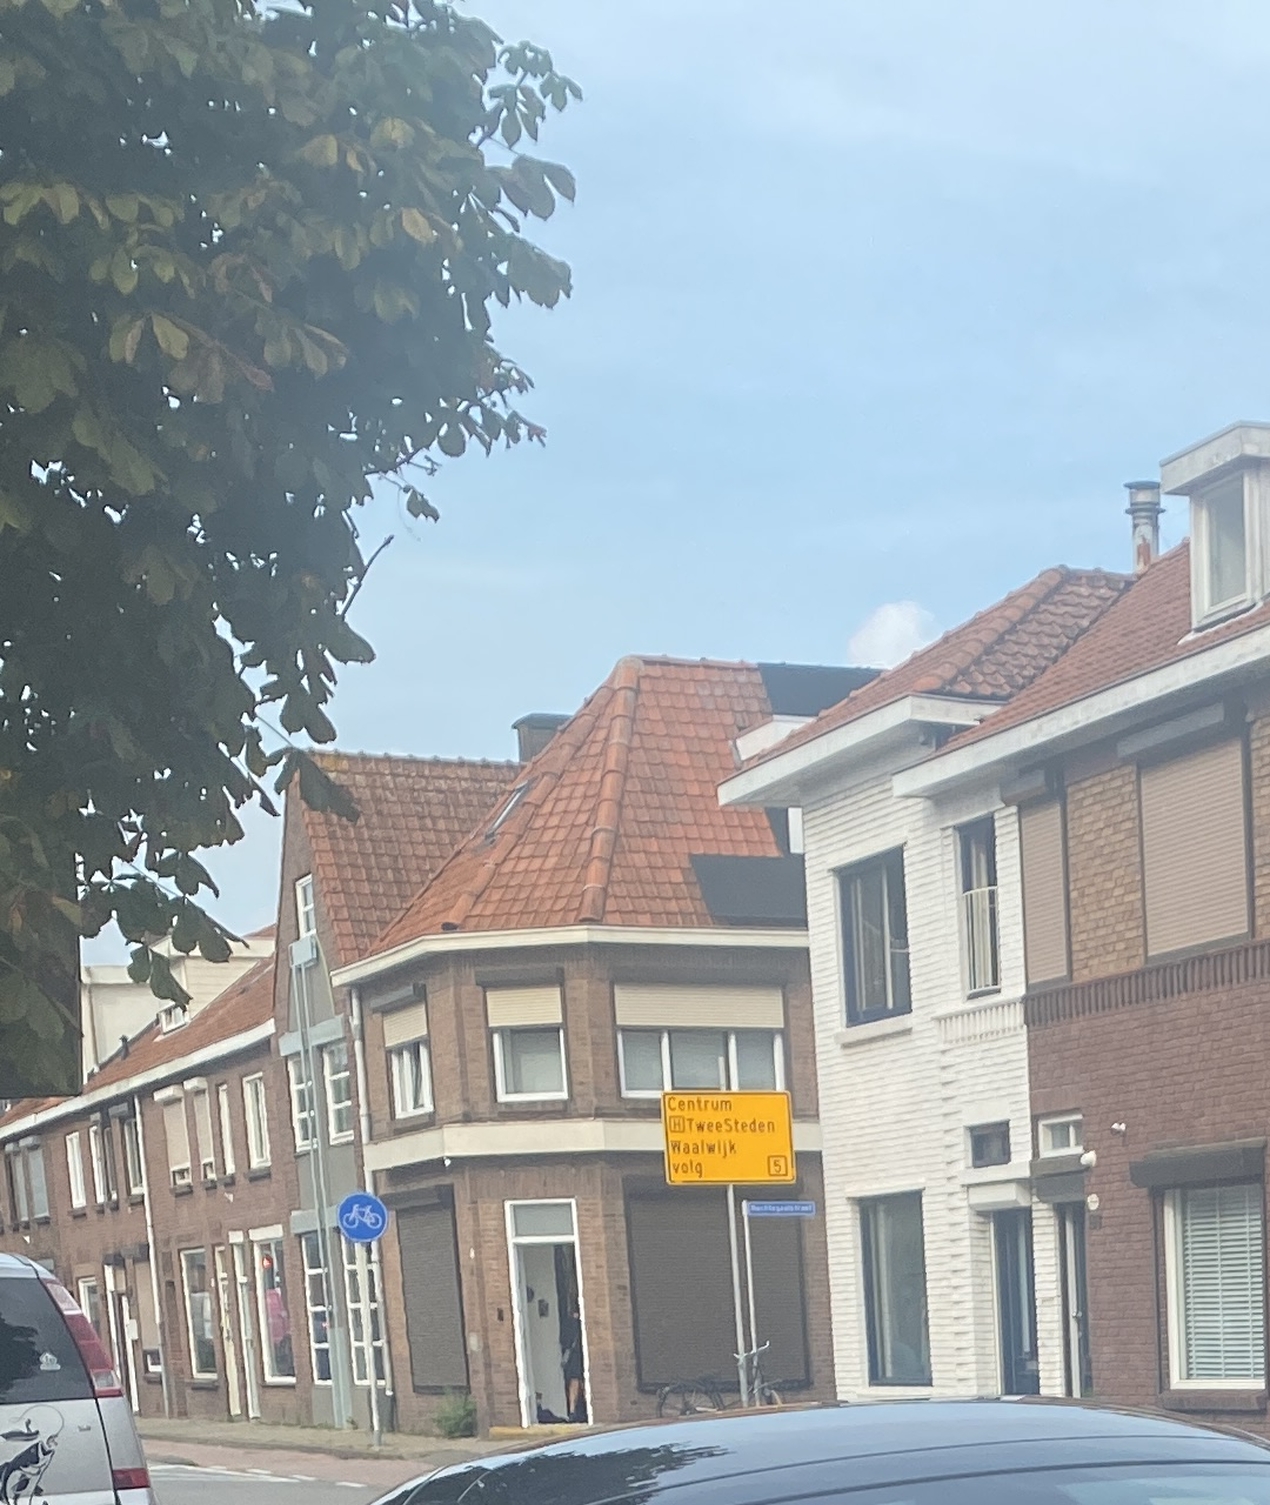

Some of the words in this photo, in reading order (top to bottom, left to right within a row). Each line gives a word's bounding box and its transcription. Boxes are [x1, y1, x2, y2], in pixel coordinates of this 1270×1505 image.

[668, 1096, 733, 1112] Centrum
[687, 1118, 775, 1133] TweeSteden
[671, 1139, 737, 1158] Waalwijk
[672, 1160, 703, 1178] volg
[773, 1160, 782, 1173] 5
